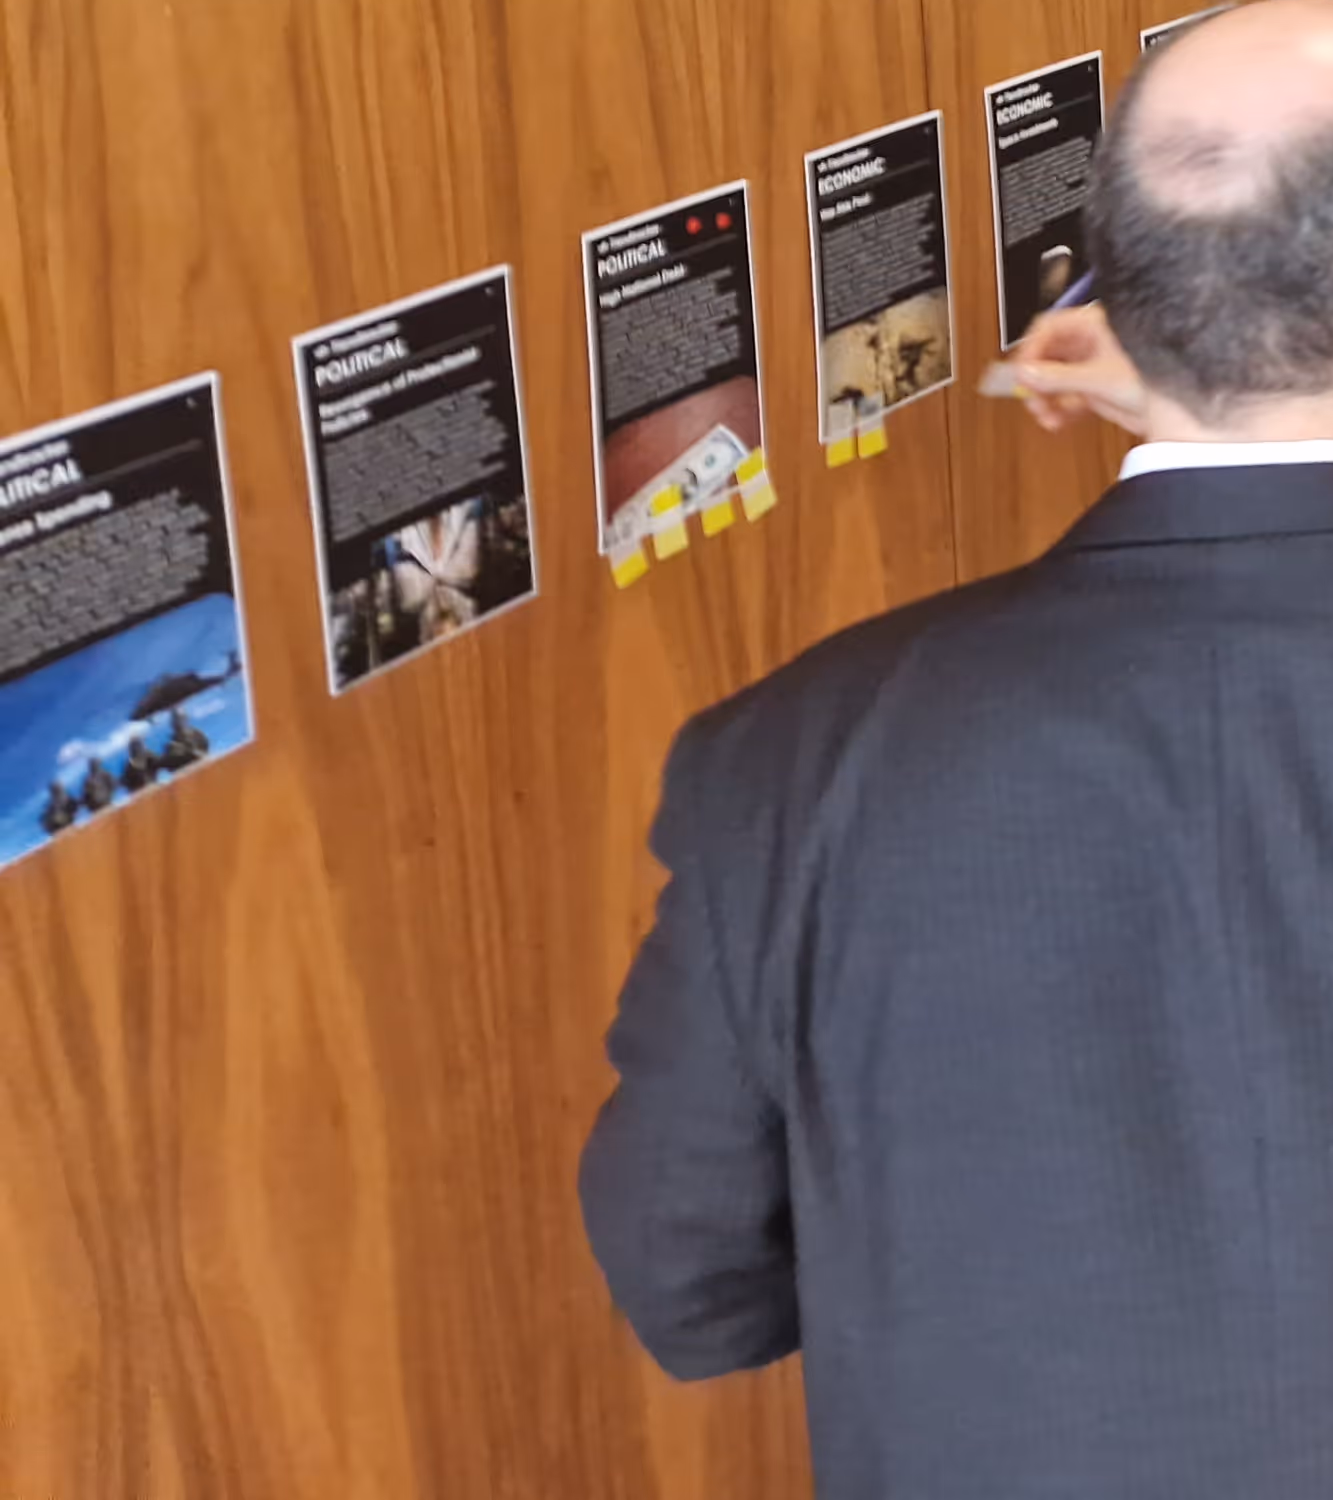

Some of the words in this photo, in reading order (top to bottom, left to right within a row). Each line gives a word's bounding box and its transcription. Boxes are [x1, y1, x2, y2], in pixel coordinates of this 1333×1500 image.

[996, 91, 1054, 127] ECONOMIC
[818, 156, 887, 197] ECONOMIC
[597, 237, 667, 279] POLITICAL
[314, 336, 410, 388] POLITICAL
